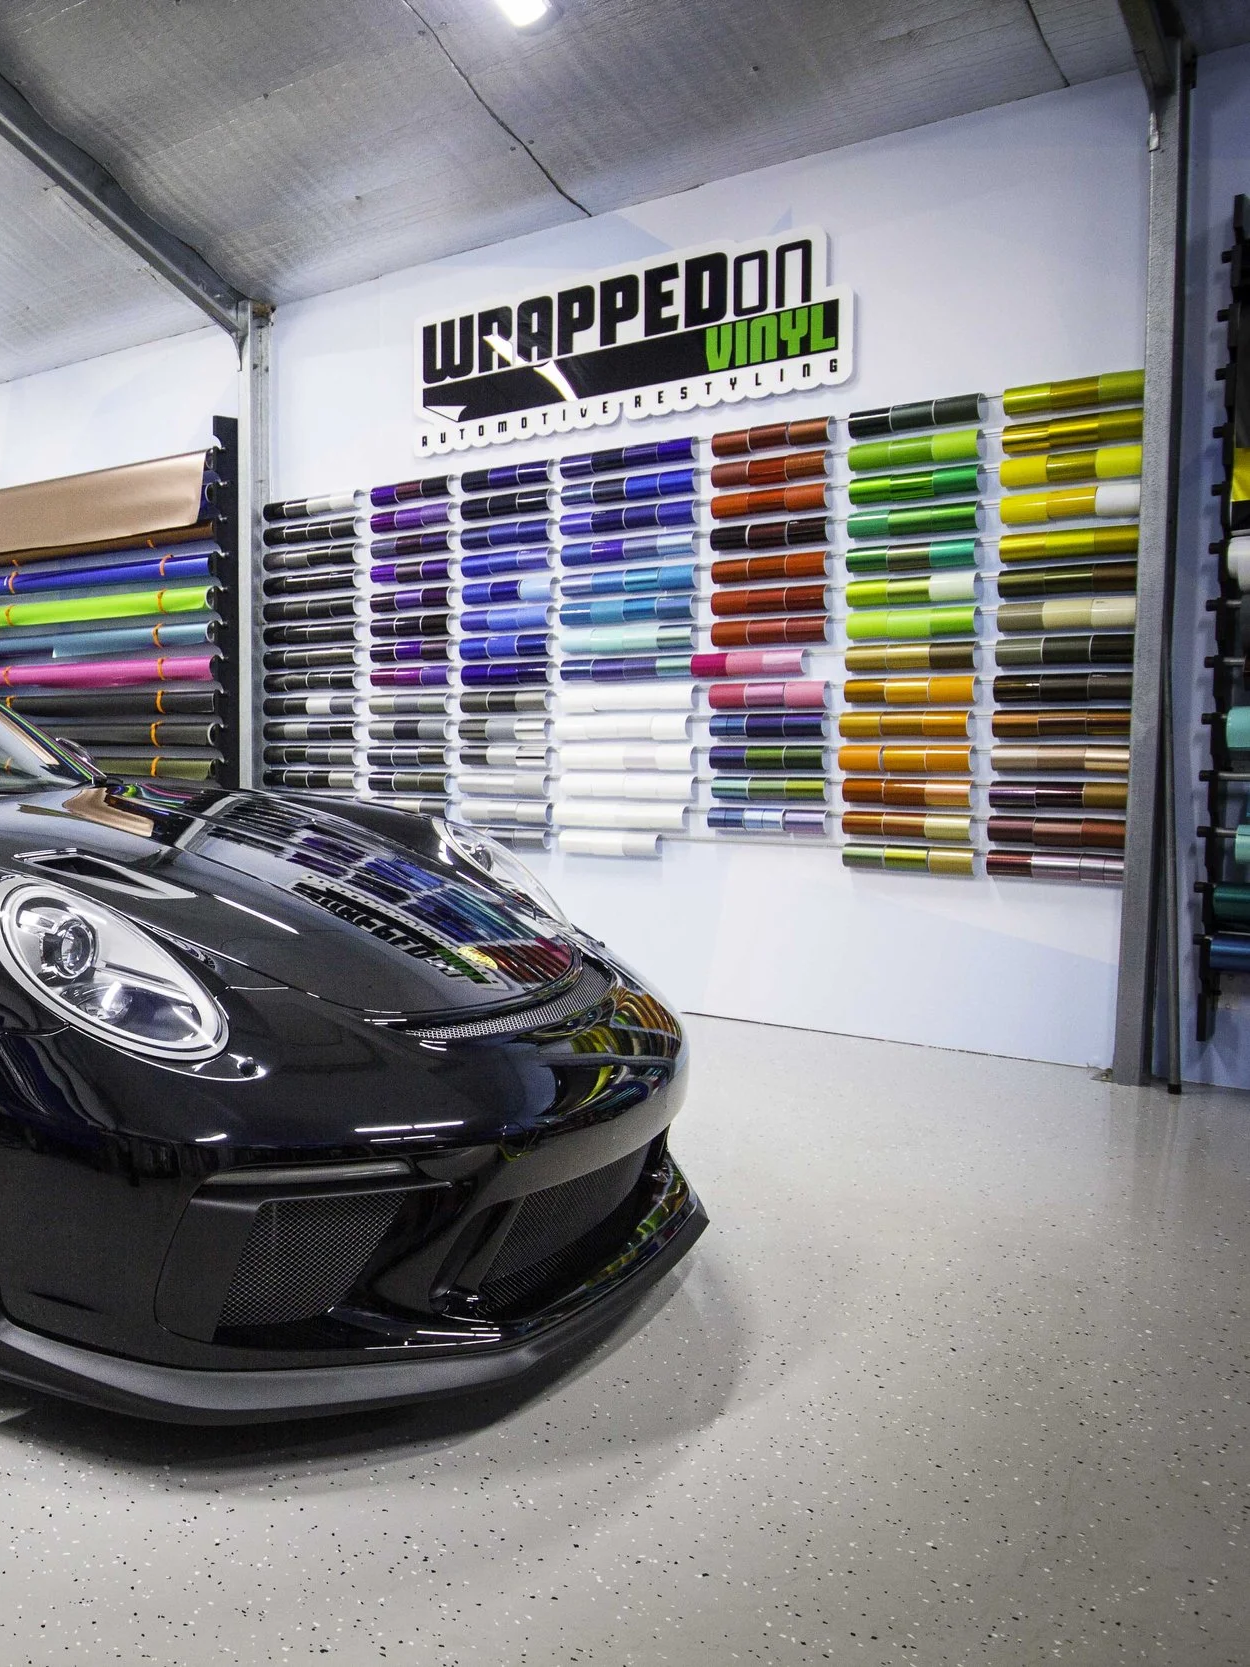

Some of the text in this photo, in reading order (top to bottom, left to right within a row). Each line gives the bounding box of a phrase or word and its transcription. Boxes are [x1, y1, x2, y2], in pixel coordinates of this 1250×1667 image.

[705, 303, 836, 372] VINYL
[421, 358, 838, 447] AUTOMOTIVE RESTYLING
